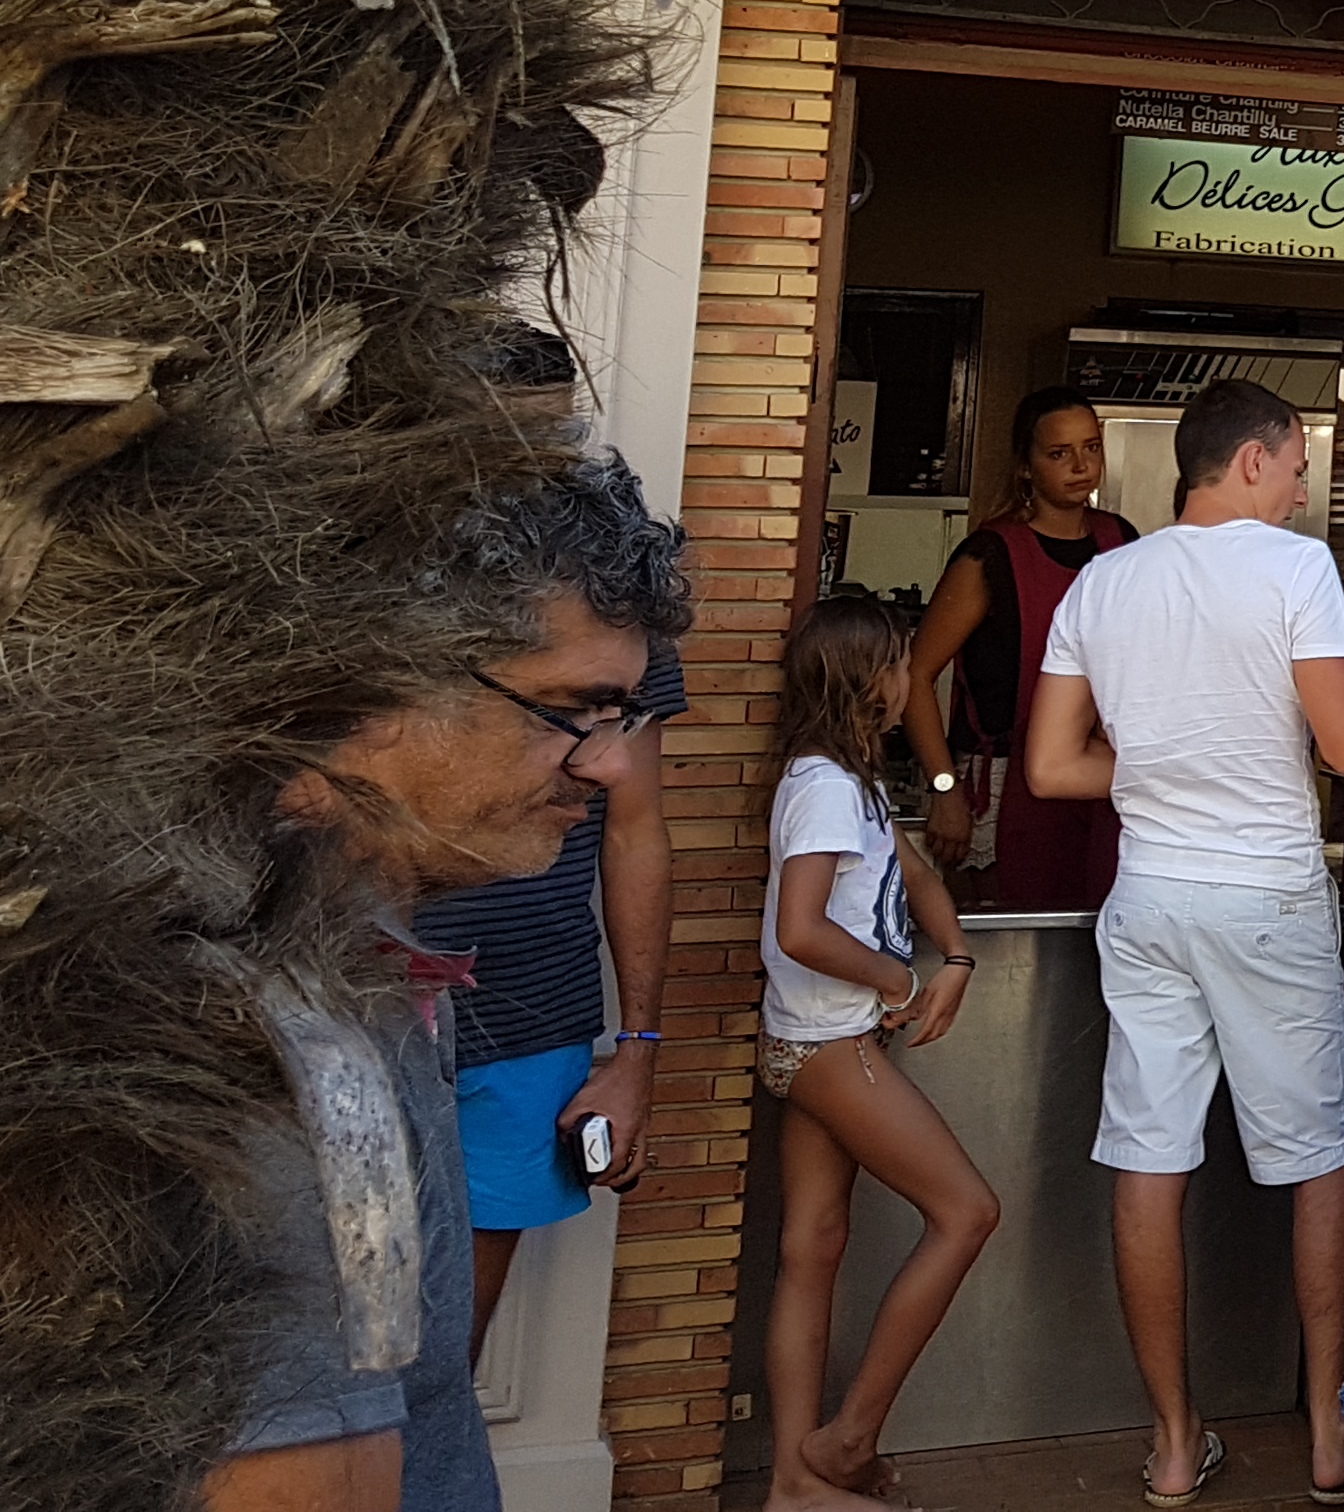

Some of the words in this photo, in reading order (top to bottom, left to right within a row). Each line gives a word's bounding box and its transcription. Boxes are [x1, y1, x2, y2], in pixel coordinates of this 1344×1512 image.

[1115, 115, 1186, 132] CARAMEL
[1192, 122, 1250, 137] BEURRE
[1259, 127, 1298, 141] SALE
[1119, 99, 1184, 119] Nutella
[1191, 104, 1277, 128] Chantilly
[1151, 159, 1308, 212] Délices
[1153, 230, 1335, 260] Fabrication
